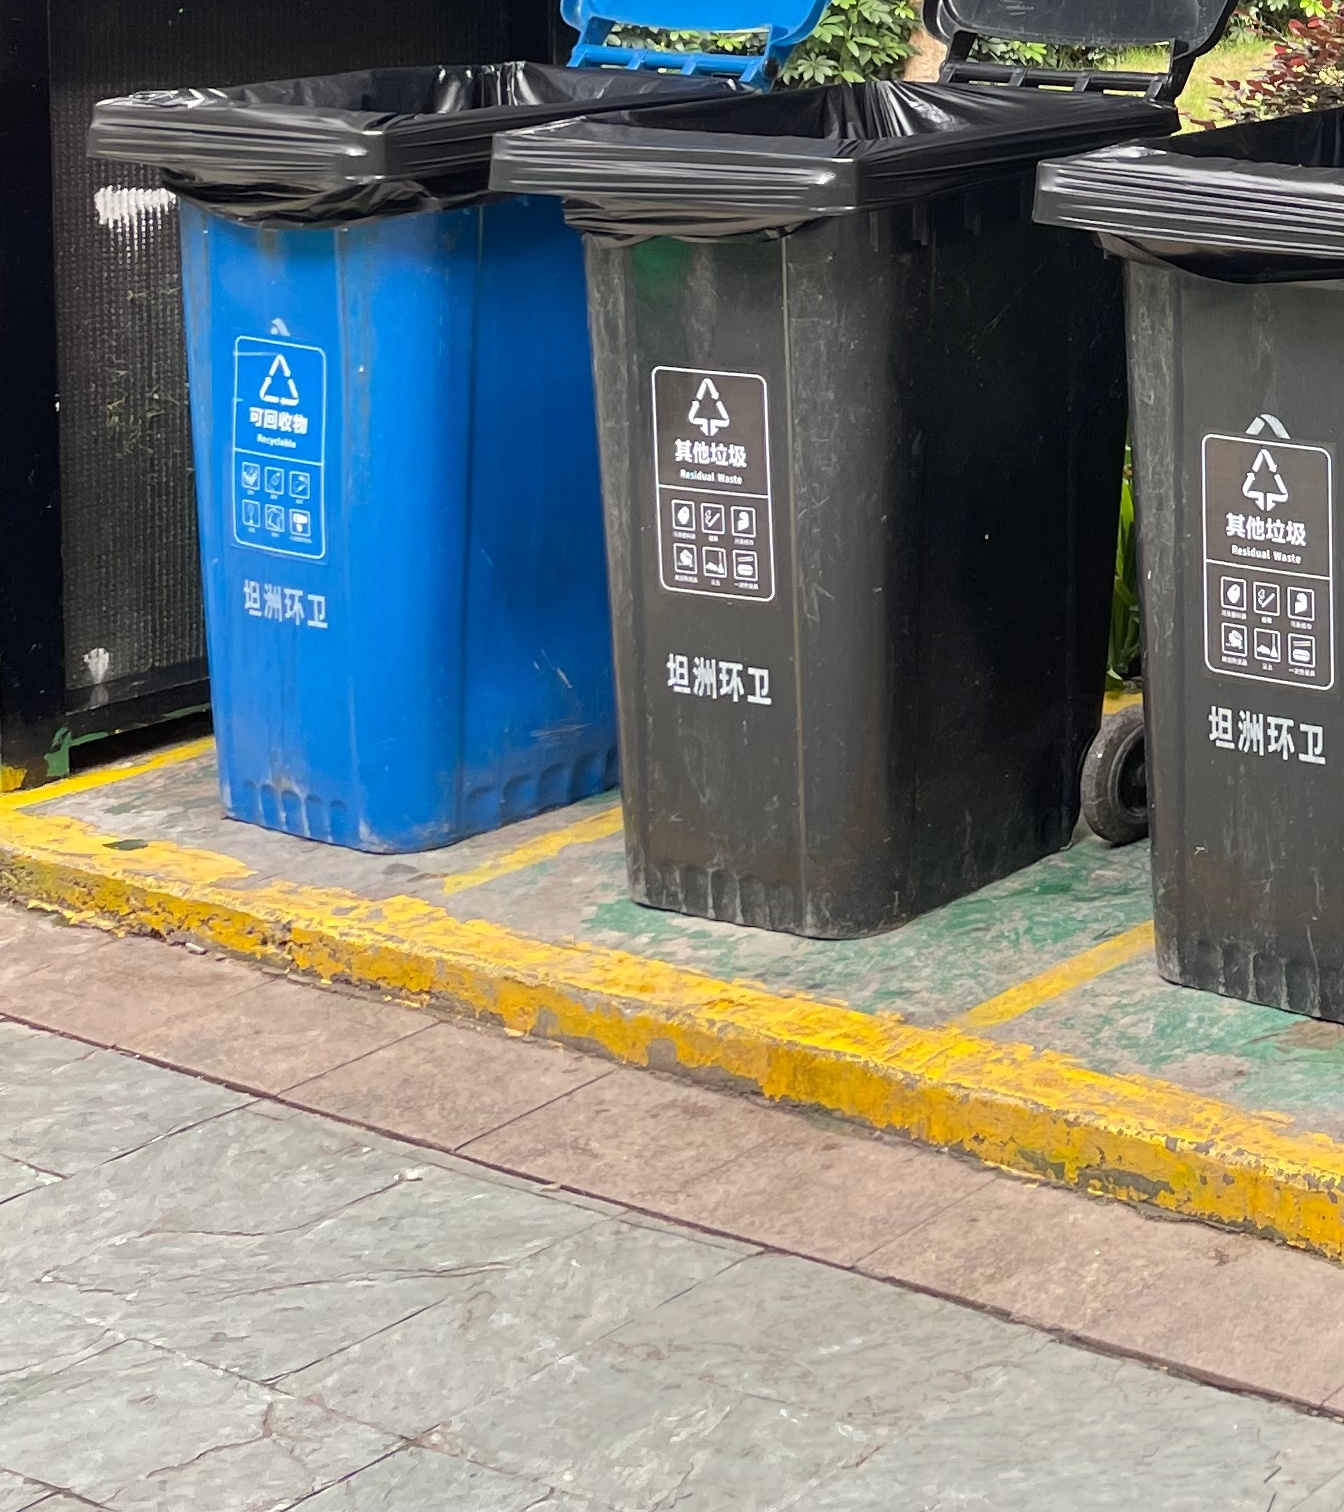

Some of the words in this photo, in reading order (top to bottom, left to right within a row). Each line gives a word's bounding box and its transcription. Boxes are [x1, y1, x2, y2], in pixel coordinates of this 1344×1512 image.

[249, 407, 308, 434] 可回收物
[257, 433, 297, 449] Recyclable
[675, 439, 747, 469] 其他垃圾
[680, 468, 715, 483] Residual
[718, 472, 743, 485] Waste
[1225, 512, 1306, 547] 其他垃圾
[1231, 544, 1271, 561] Residual
[1273, 550, 1302, 565] Waste
[243, 579, 329, 630] 坦洲环卫
[666, 653, 772, 706] 坦洲环卫
[1208, 705, 1327, 765] 坦洲环卫
